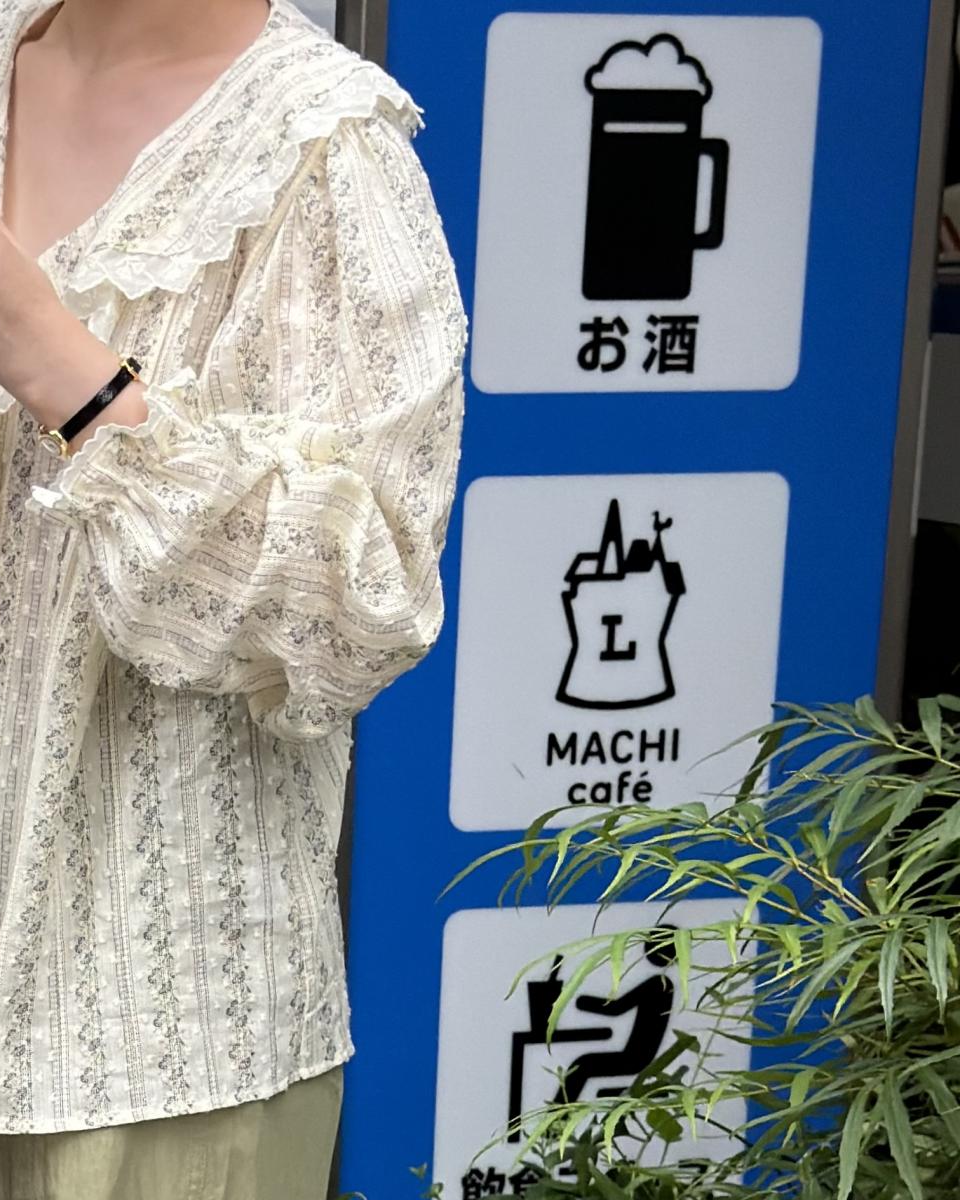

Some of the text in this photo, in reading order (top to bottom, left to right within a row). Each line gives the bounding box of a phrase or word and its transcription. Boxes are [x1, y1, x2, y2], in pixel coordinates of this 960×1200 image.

[577, 314, 700, 374] お酒
[599, 614, 637, 662] L
[546, 728, 680, 767] MACHI
[567, 771, 653, 805] café
